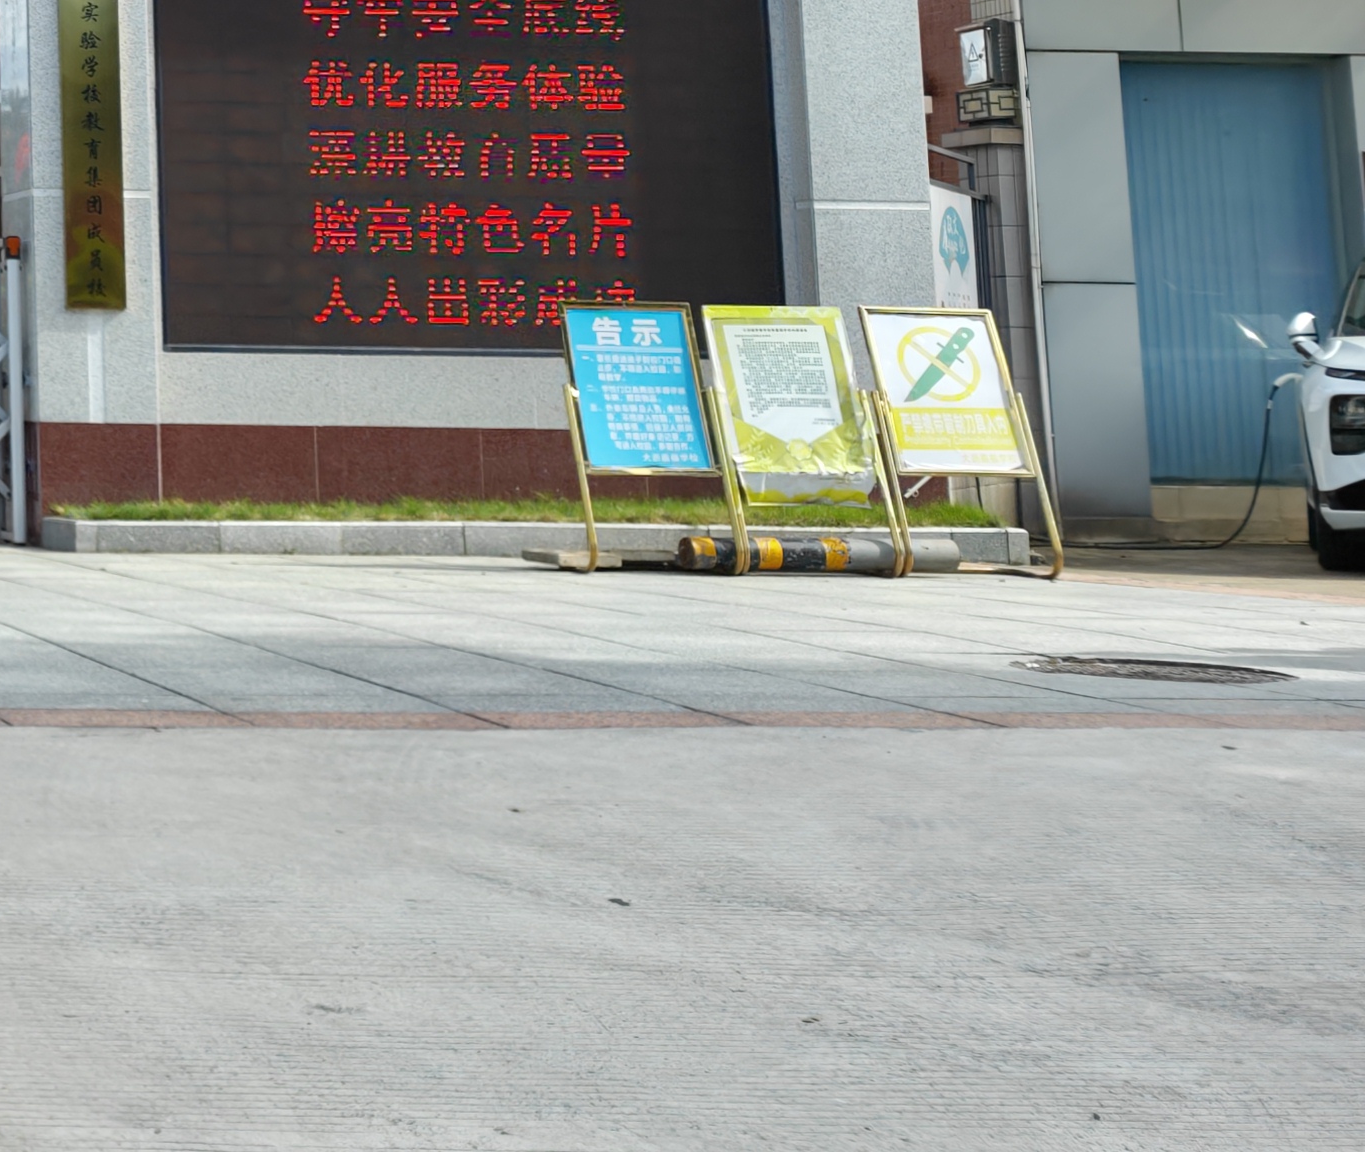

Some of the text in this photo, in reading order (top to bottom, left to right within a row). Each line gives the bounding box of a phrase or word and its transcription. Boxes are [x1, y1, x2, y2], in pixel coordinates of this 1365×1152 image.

[303, 60, 627, 111] 优化服务体验
[308, 130, 631, 180] 深耕教育质量
[313, 199, 633, 257] 擦亮特色名片
[592, 316, 663, 346] 告示
